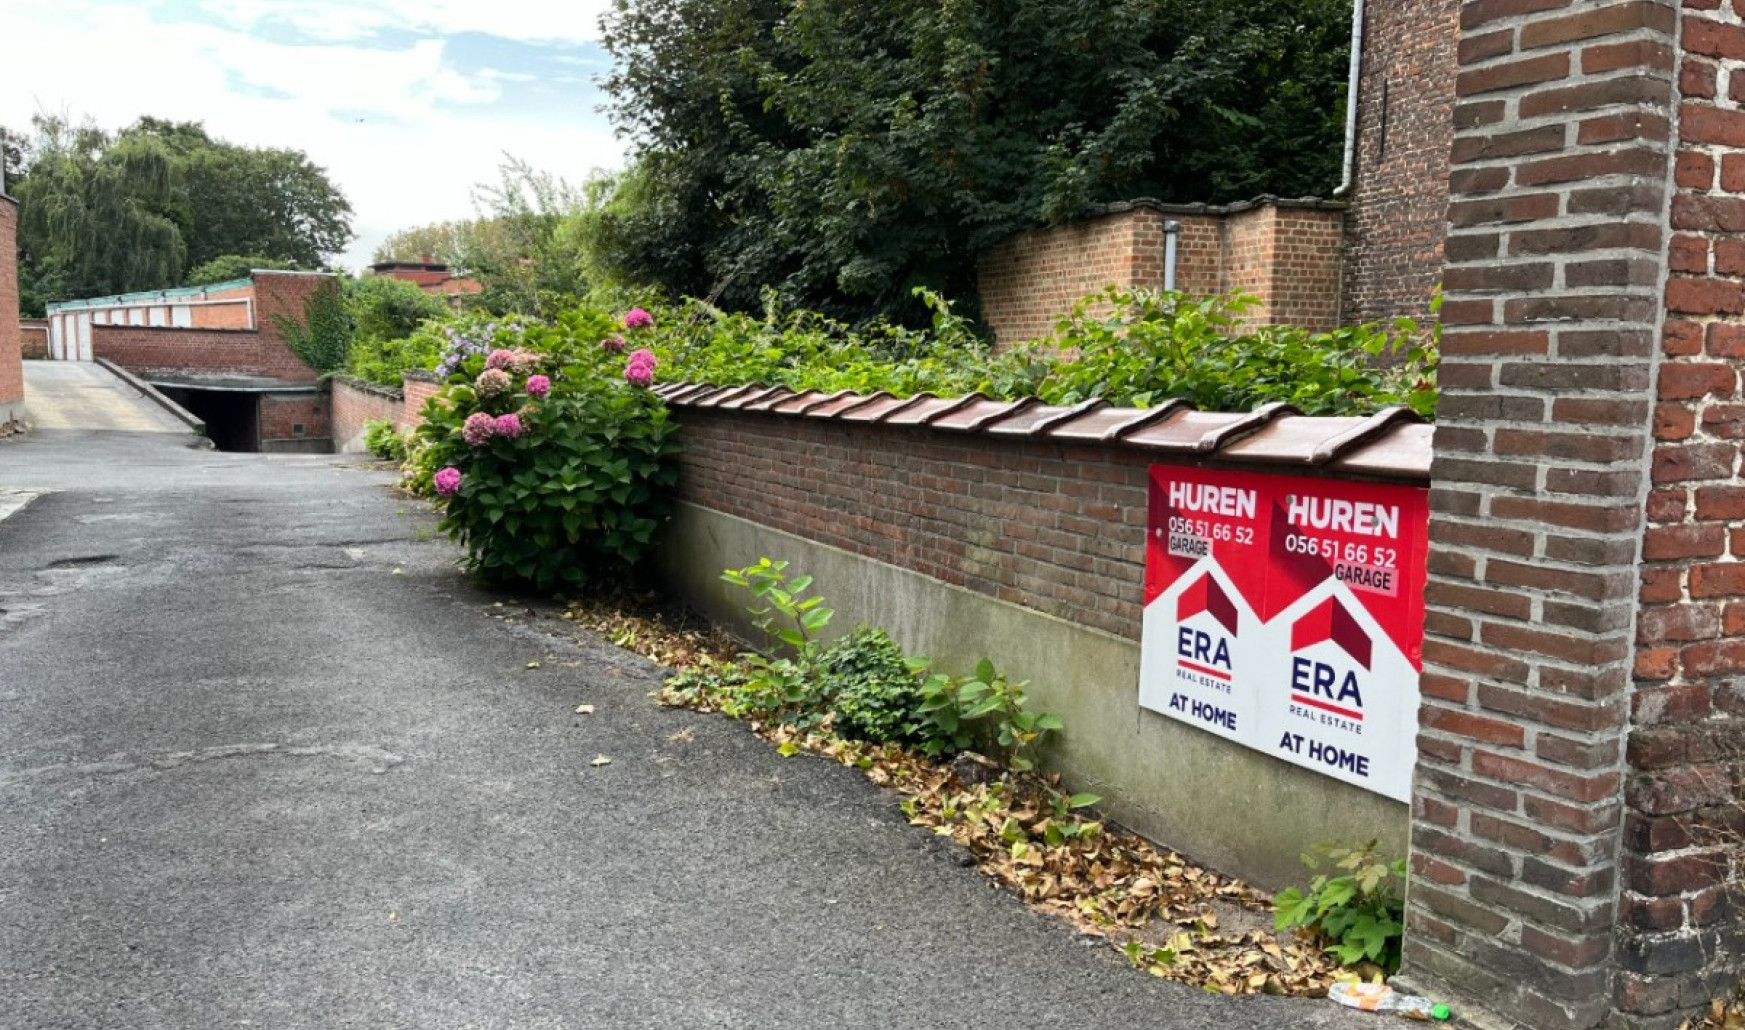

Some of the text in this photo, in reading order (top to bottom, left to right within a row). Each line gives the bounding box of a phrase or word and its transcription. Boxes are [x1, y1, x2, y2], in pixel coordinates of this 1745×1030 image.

[1169, 481, 1257, 519] HUREN
[1287, 494, 1399, 539] HUREN
[1168, 516, 1254, 545] 056 51 66 52
[1170, 535, 1208, 556] GARAGE
[1285, 533, 1396, 568] 056 51 66 52
[1335, 563, 1392, 590] GARAGE
[1178, 626, 1232, 670] ERA
[1176, 669, 1231, 694] REAL ESTATE
[1291, 656, 1363, 707] ERA
[1169, 692, 1237, 731] AT HOME
[1289, 704, 1362, 735] REAL ESTATE
[1280, 731, 1370, 777] AT HOME
